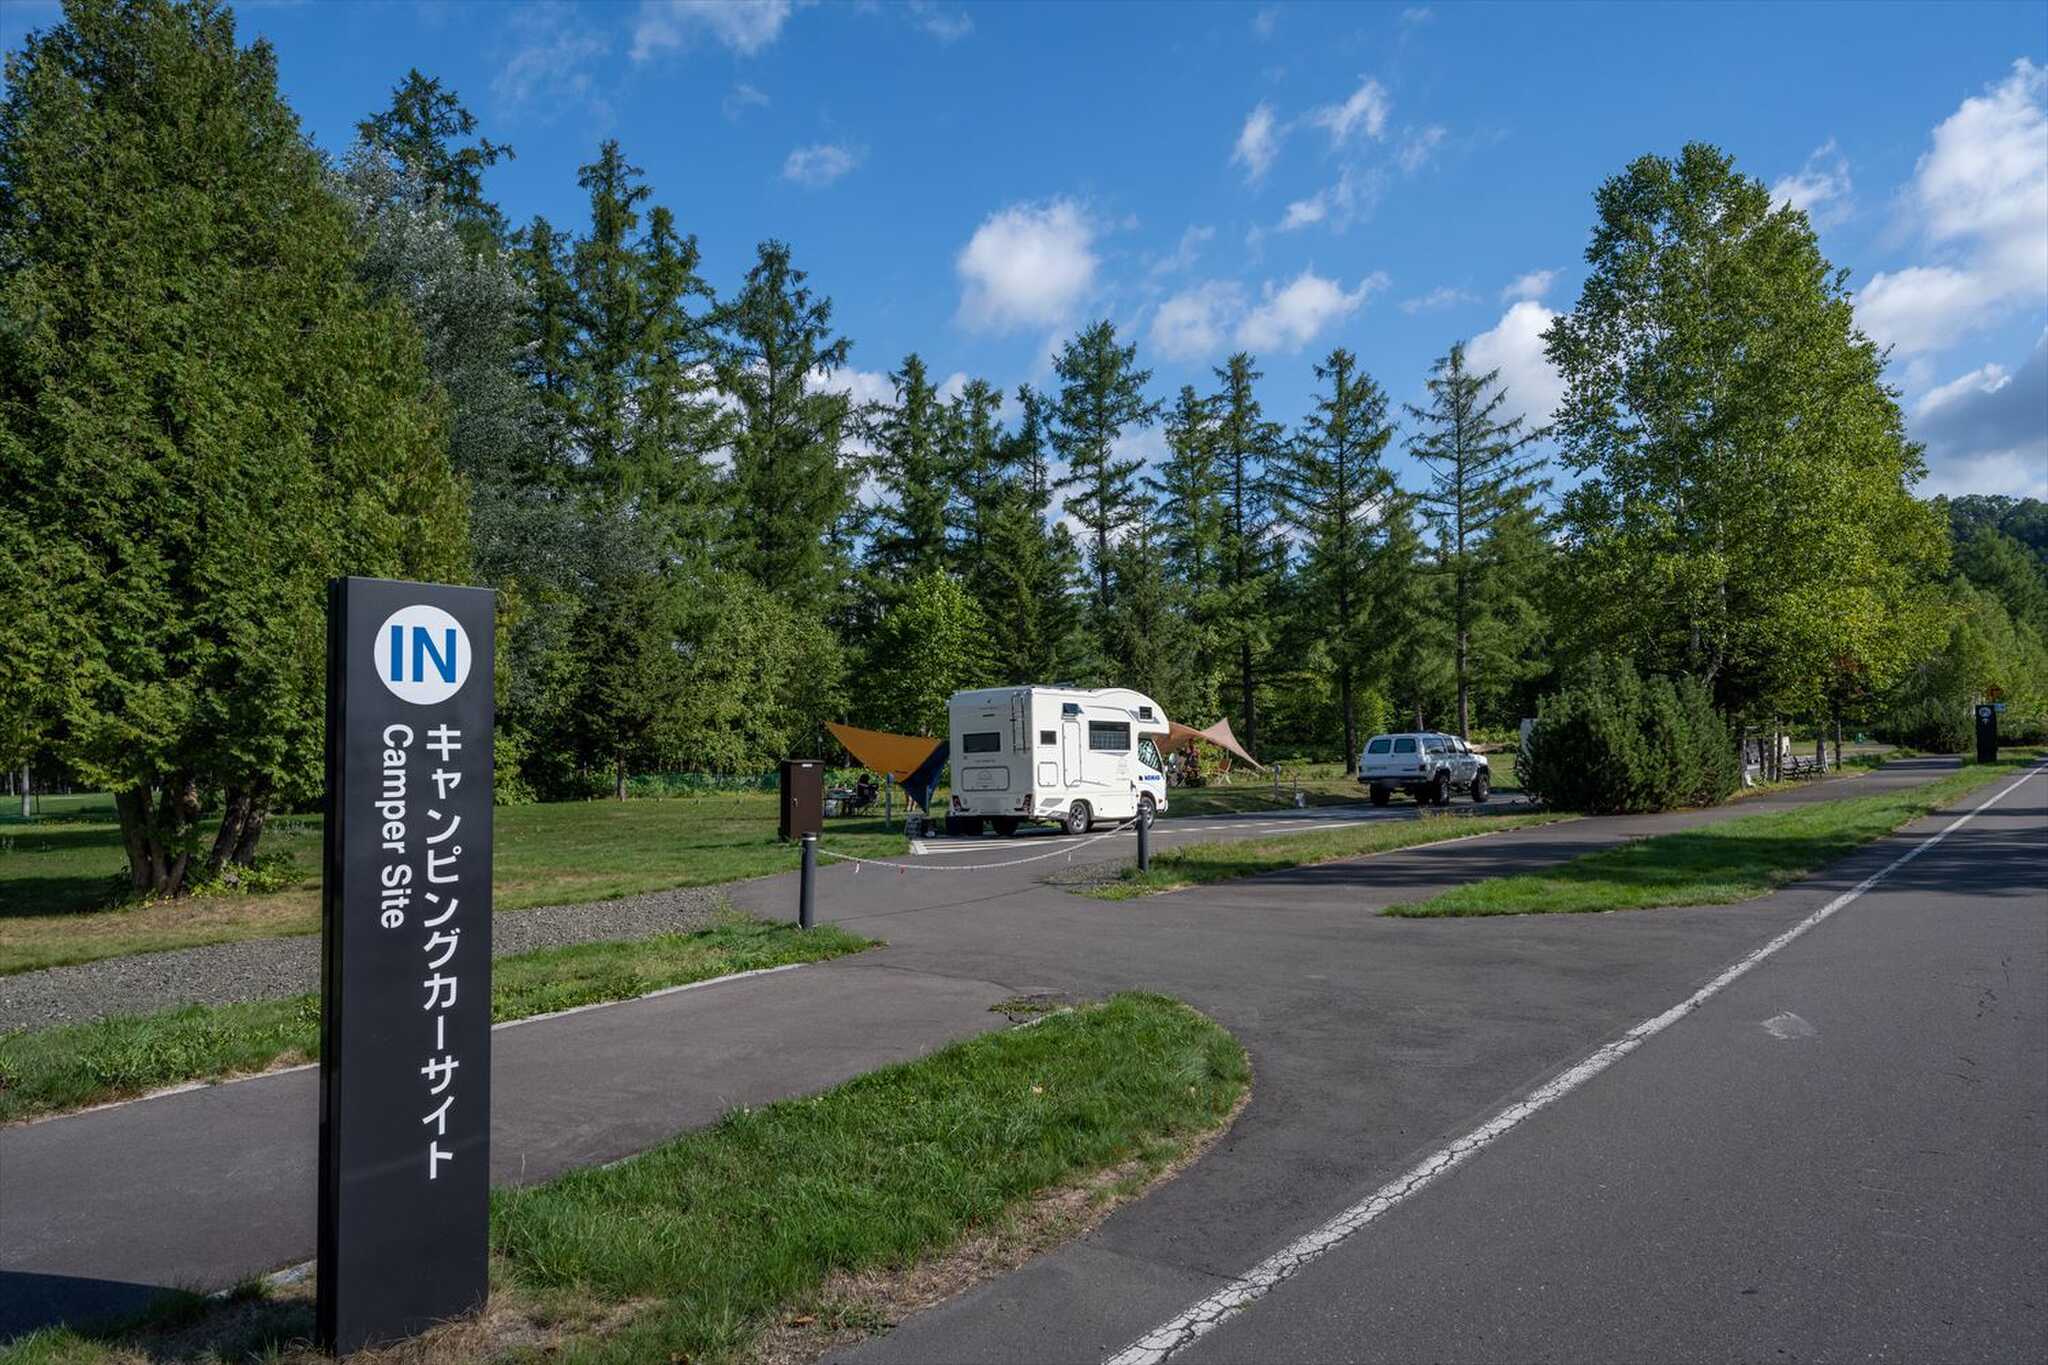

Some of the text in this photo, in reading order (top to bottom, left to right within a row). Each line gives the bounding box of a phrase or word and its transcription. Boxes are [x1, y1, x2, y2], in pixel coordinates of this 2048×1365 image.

[390, 625, 457, 683] IN
[375, 724, 414, 929] Camper Site
[420, 723, 462, 1180] キャンピングカーサイト
